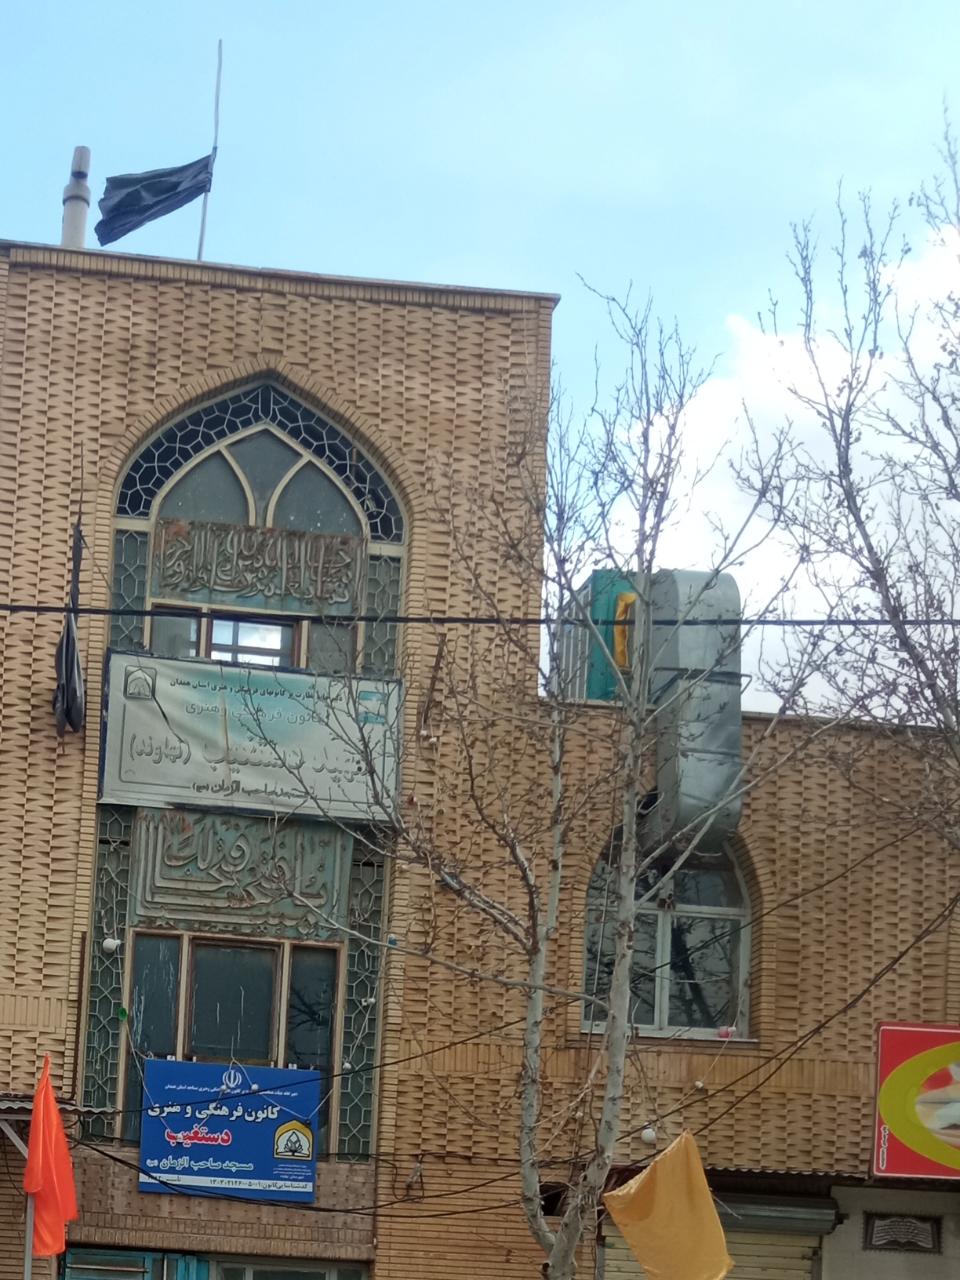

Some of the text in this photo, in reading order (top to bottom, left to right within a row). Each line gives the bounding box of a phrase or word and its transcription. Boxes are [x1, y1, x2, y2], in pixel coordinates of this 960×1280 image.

[147, 1101, 280, 1122] کانون فرهنگی و هنری
[165, 1123, 232, 1147] دستغیب
[159, 1155, 190, 1170] الزمان
[190, 1157, 222, 1171] صاحب
[222, 1159, 254, 1173] مسجد
